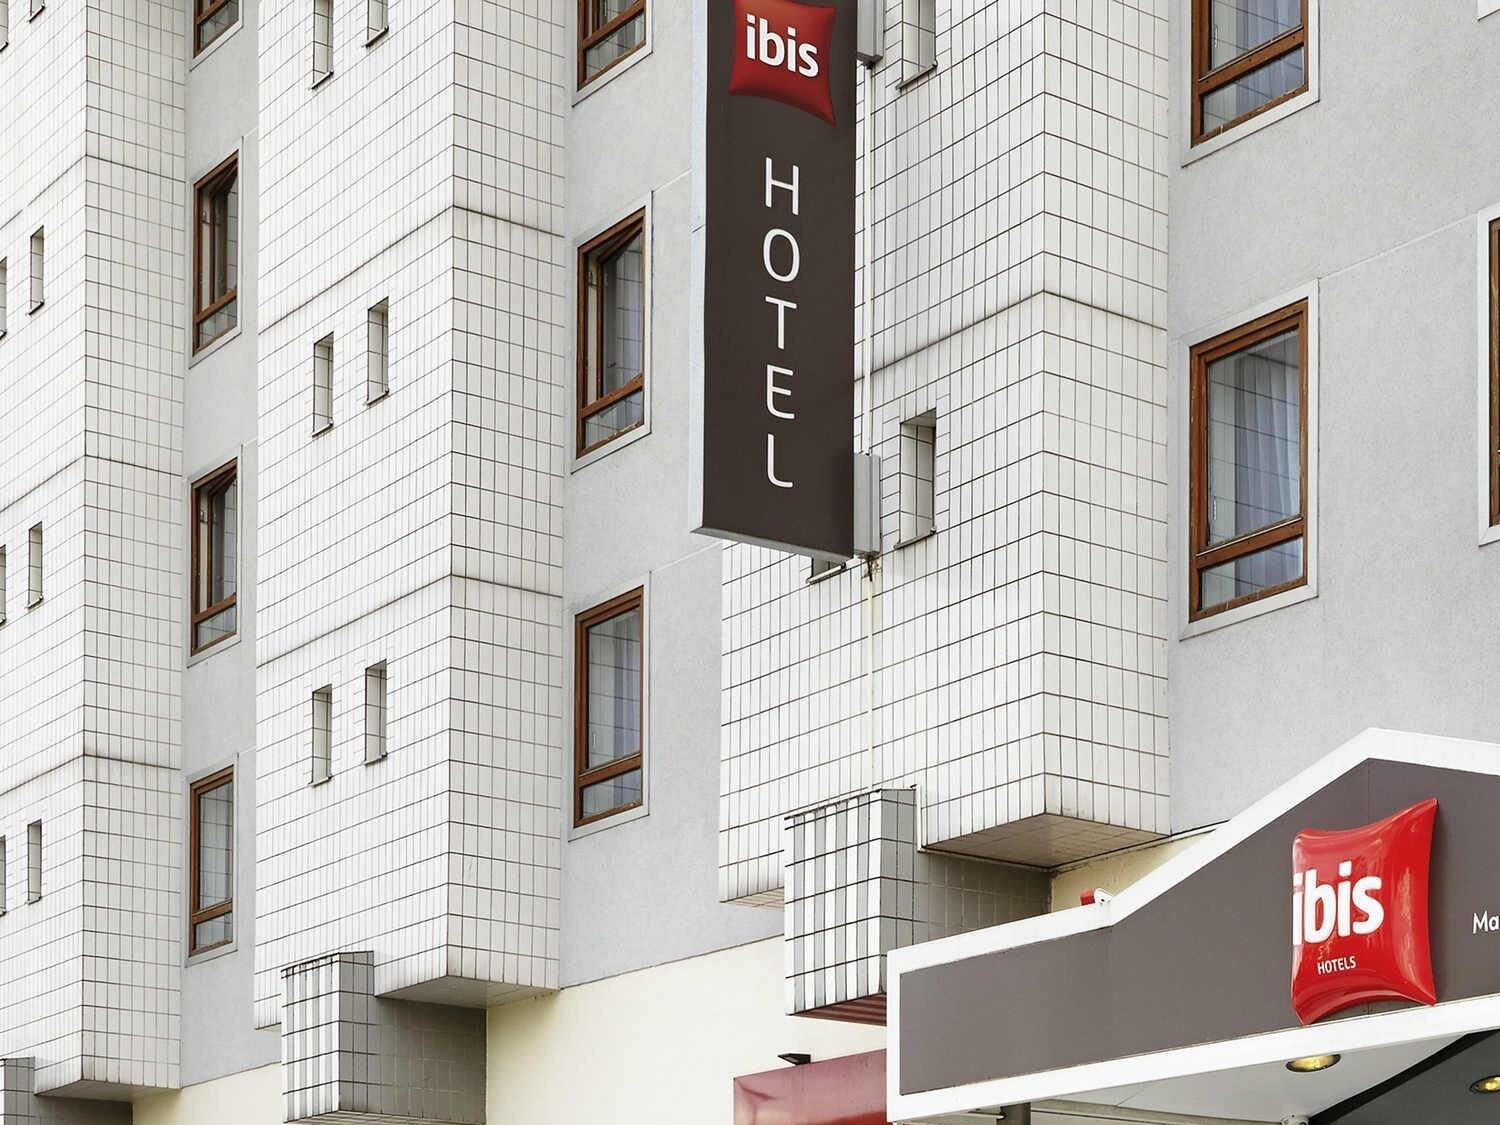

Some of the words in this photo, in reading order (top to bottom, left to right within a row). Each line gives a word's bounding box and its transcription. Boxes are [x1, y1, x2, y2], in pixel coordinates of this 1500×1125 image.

[745, 15, 820, 78] ibis
[762, 156, 801, 488] HOTEL
[1292, 861, 1385, 946] ibis
[1316, 956, 1357, 974] HOTELS
